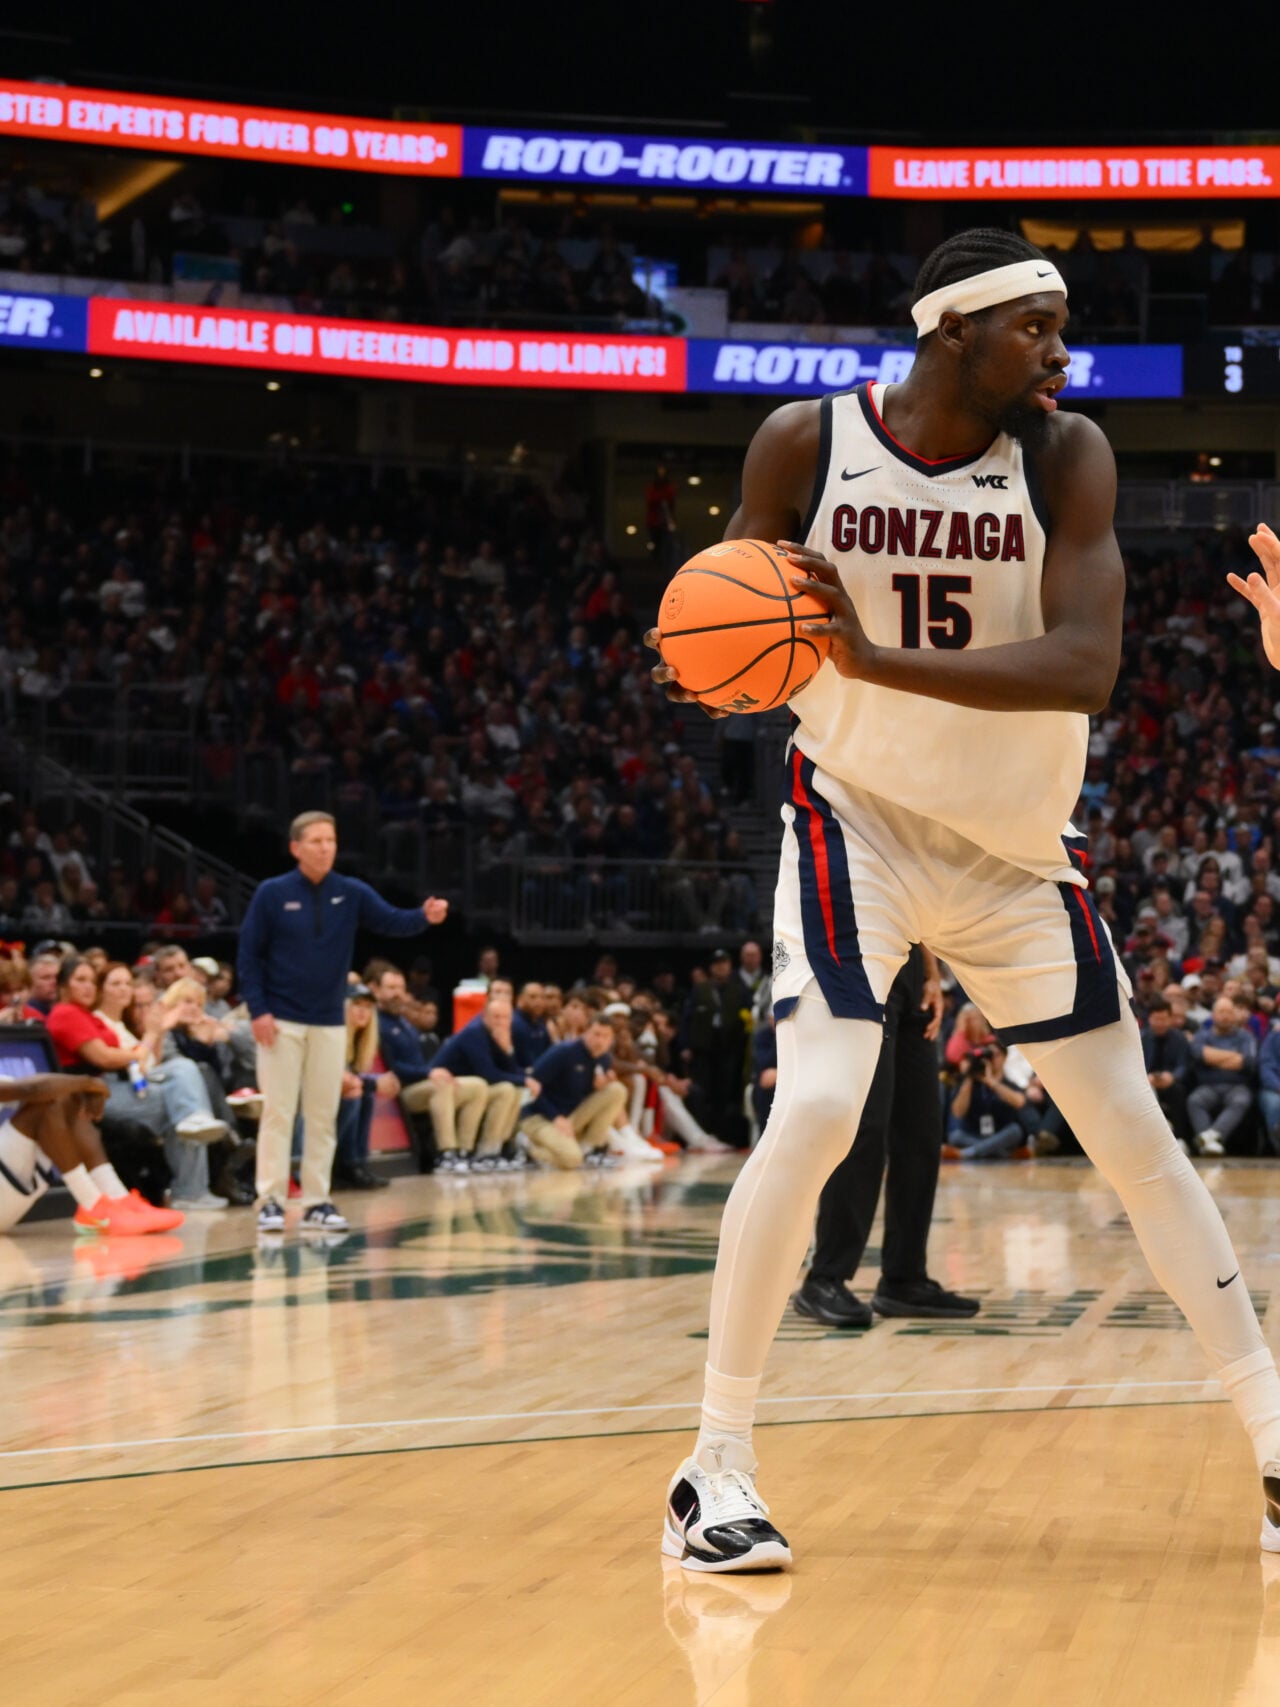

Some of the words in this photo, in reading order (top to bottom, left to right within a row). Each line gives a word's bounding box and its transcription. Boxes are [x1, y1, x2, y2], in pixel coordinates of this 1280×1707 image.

[68, 100, 184, 139] EXPERTS
[189, 113, 239, 145] FOR
[243, 119, 310, 152] OVER
[895, 160, 969, 187] LEAVE
[974, 160, 1102, 187] PLUMBING
[1107, 160, 1140, 186] TO
[1144, 160, 1192, 186] THE
[1197, 159, 1272, 186] PROS.
[113, 309, 269, 352] AVAILABLE
[274, 323, 313, 356] ON
[319, 328, 449, 367] WEEKEND
[455, 339, 514, 371] AND
[520, 343, 666, 376] HOLIDAYS!
[1225, 364, 1243, 392] 3
[972, 474, 1008, 489] WCC
[832, 504, 1025, 562] GONZAGA
[892, 573, 972, 650] 15
